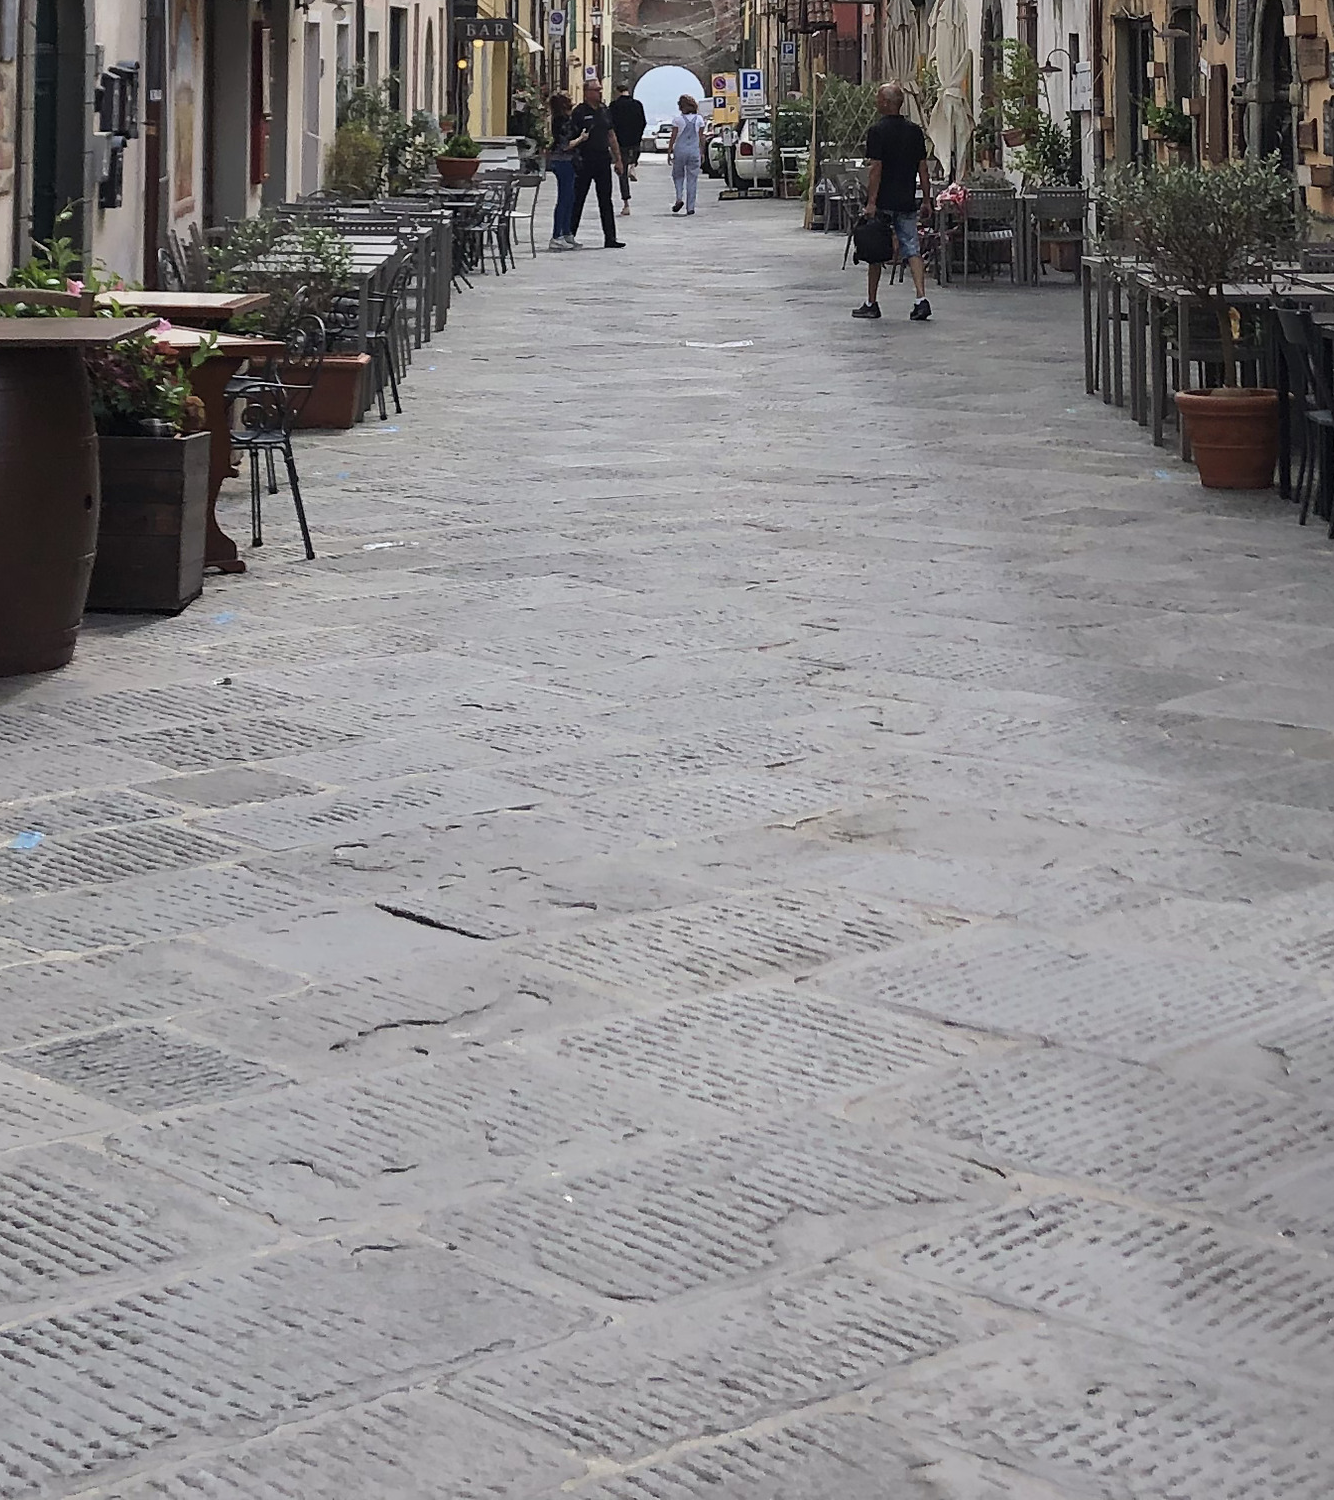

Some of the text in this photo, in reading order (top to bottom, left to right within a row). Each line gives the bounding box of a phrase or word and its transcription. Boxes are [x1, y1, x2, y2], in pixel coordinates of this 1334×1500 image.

[466, 22, 505, 37] BAR
[747, 74, 759, 89] P
[716, 98, 724, 108] P
